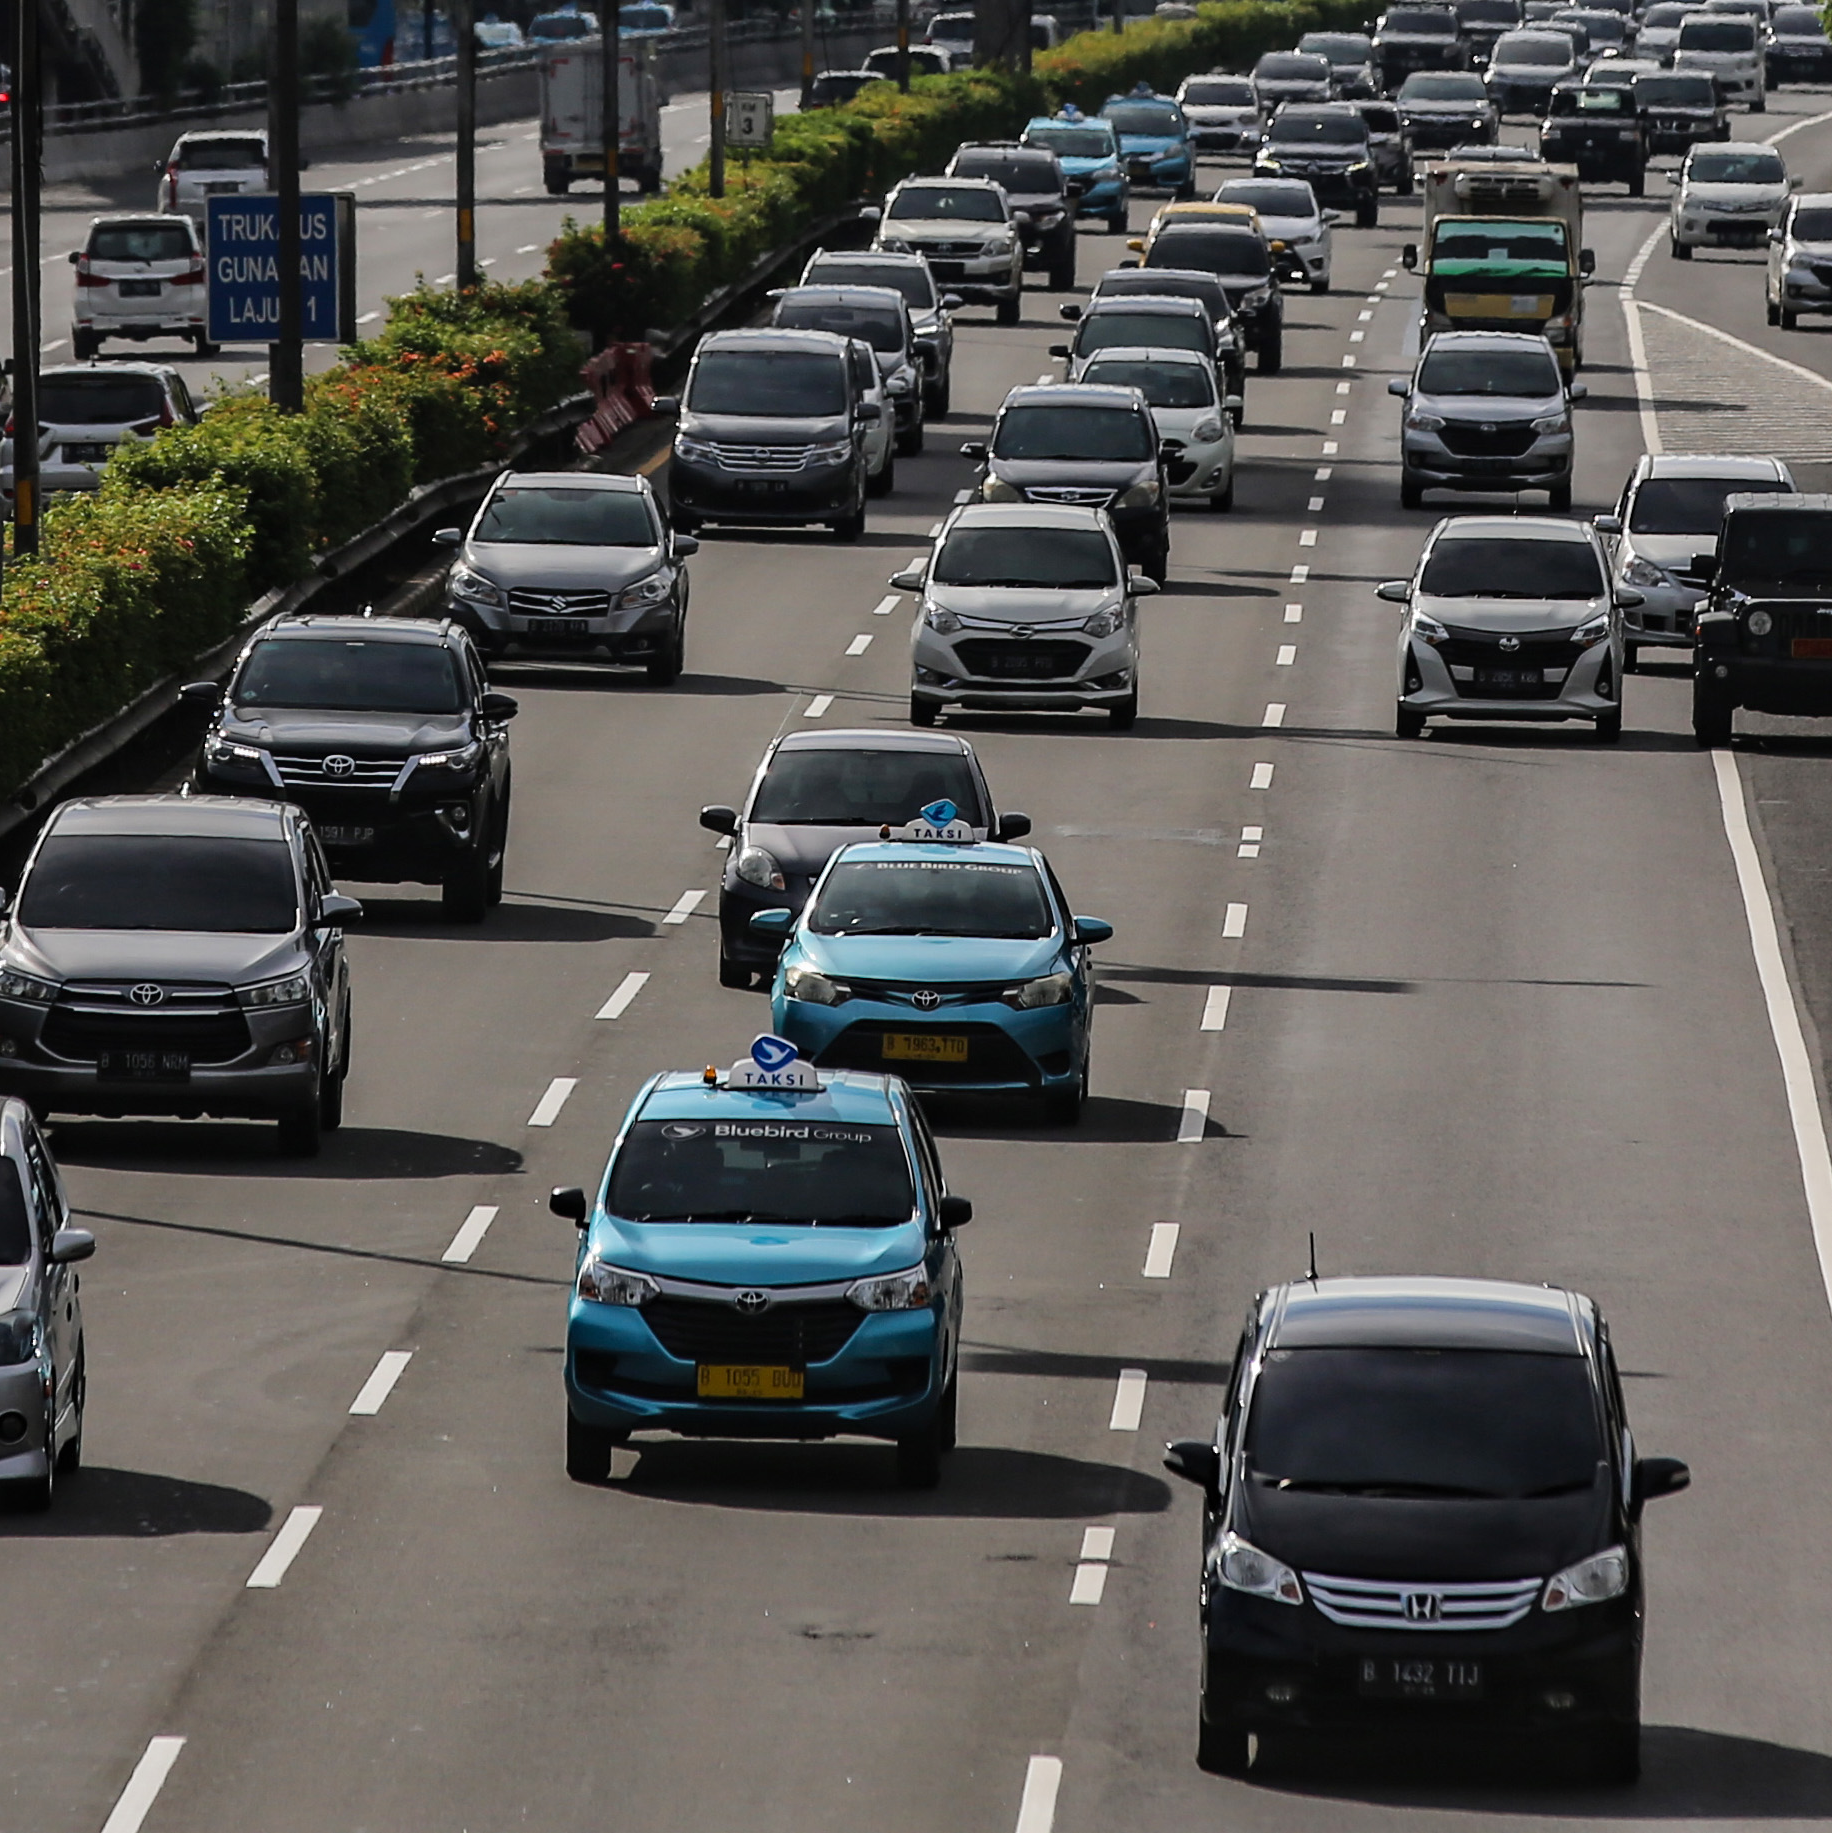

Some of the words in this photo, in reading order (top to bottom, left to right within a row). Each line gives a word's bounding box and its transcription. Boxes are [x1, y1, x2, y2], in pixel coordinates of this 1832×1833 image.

[742, 118, 753, 135] 3
[218, 255, 328, 282] GUNAAN
[229, 296, 281, 323] LAJU
[914, 828, 961, 839] TAKSI
[887, 1037, 894, 1050] B
[745, 1073, 803, 1086] TAKSI
[714, 1123, 809, 1139] Bluebird
[814, 1129, 872, 1144] Group
[701, 1367, 710, 1386] B
[725, 1367, 760, 1386] 1055
[1363, 1661, 1376, 1682] B
